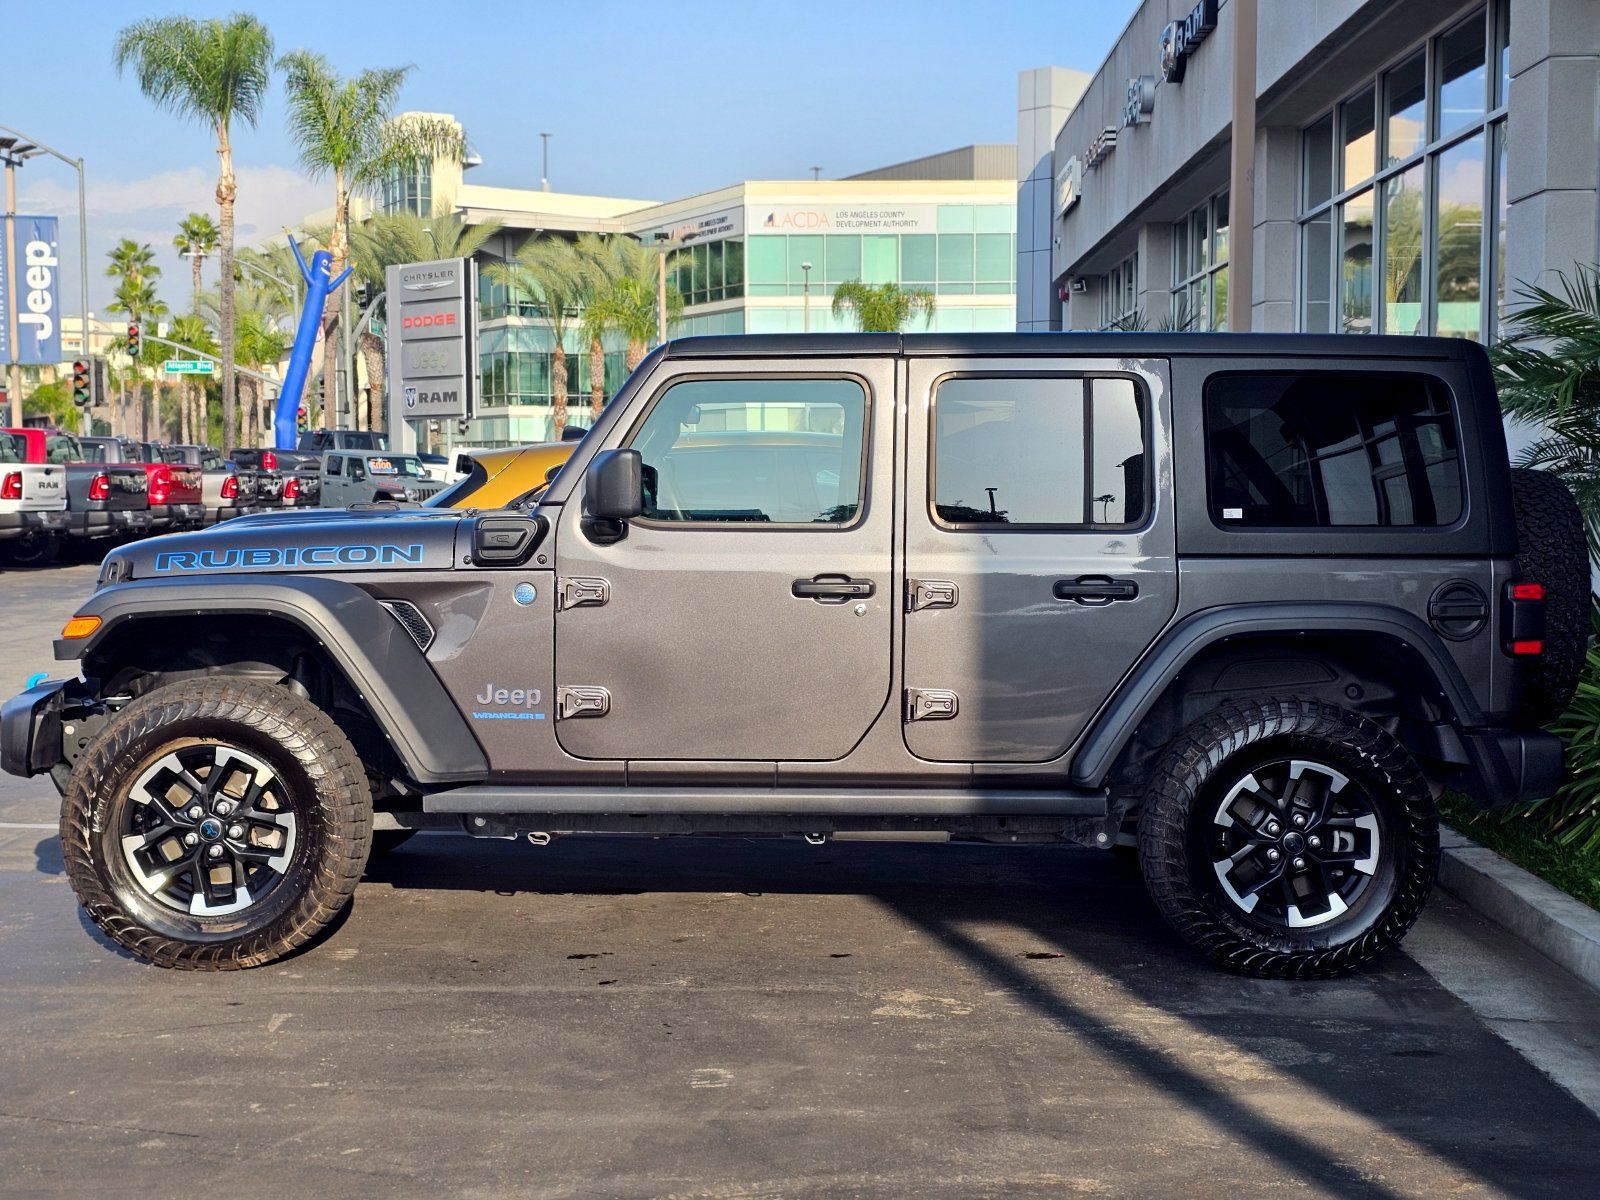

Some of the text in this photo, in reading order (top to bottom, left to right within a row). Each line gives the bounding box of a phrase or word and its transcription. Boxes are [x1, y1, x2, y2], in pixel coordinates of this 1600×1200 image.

[1175, 0, 1205, 57] RAM
[772, 211, 831, 228] LACDA
[836, 211, 905, 219] LOS ANGELES COUNTY
[836, 220, 918, 228] DEVELOPMENT AUTHORITY
[403, 270, 454, 282] CHRYSLER
[18, 240, 58, 340] Jeep
[402, 313, 456, 329] DODGE
[197, 361, 212, 370] Blvd
[418, 391, 458, 404] RAM
[38, 481, 59, 489] RAM
[155, 544, 424, 571] RUBICON
[476, 683, 541, 709] Jeep
